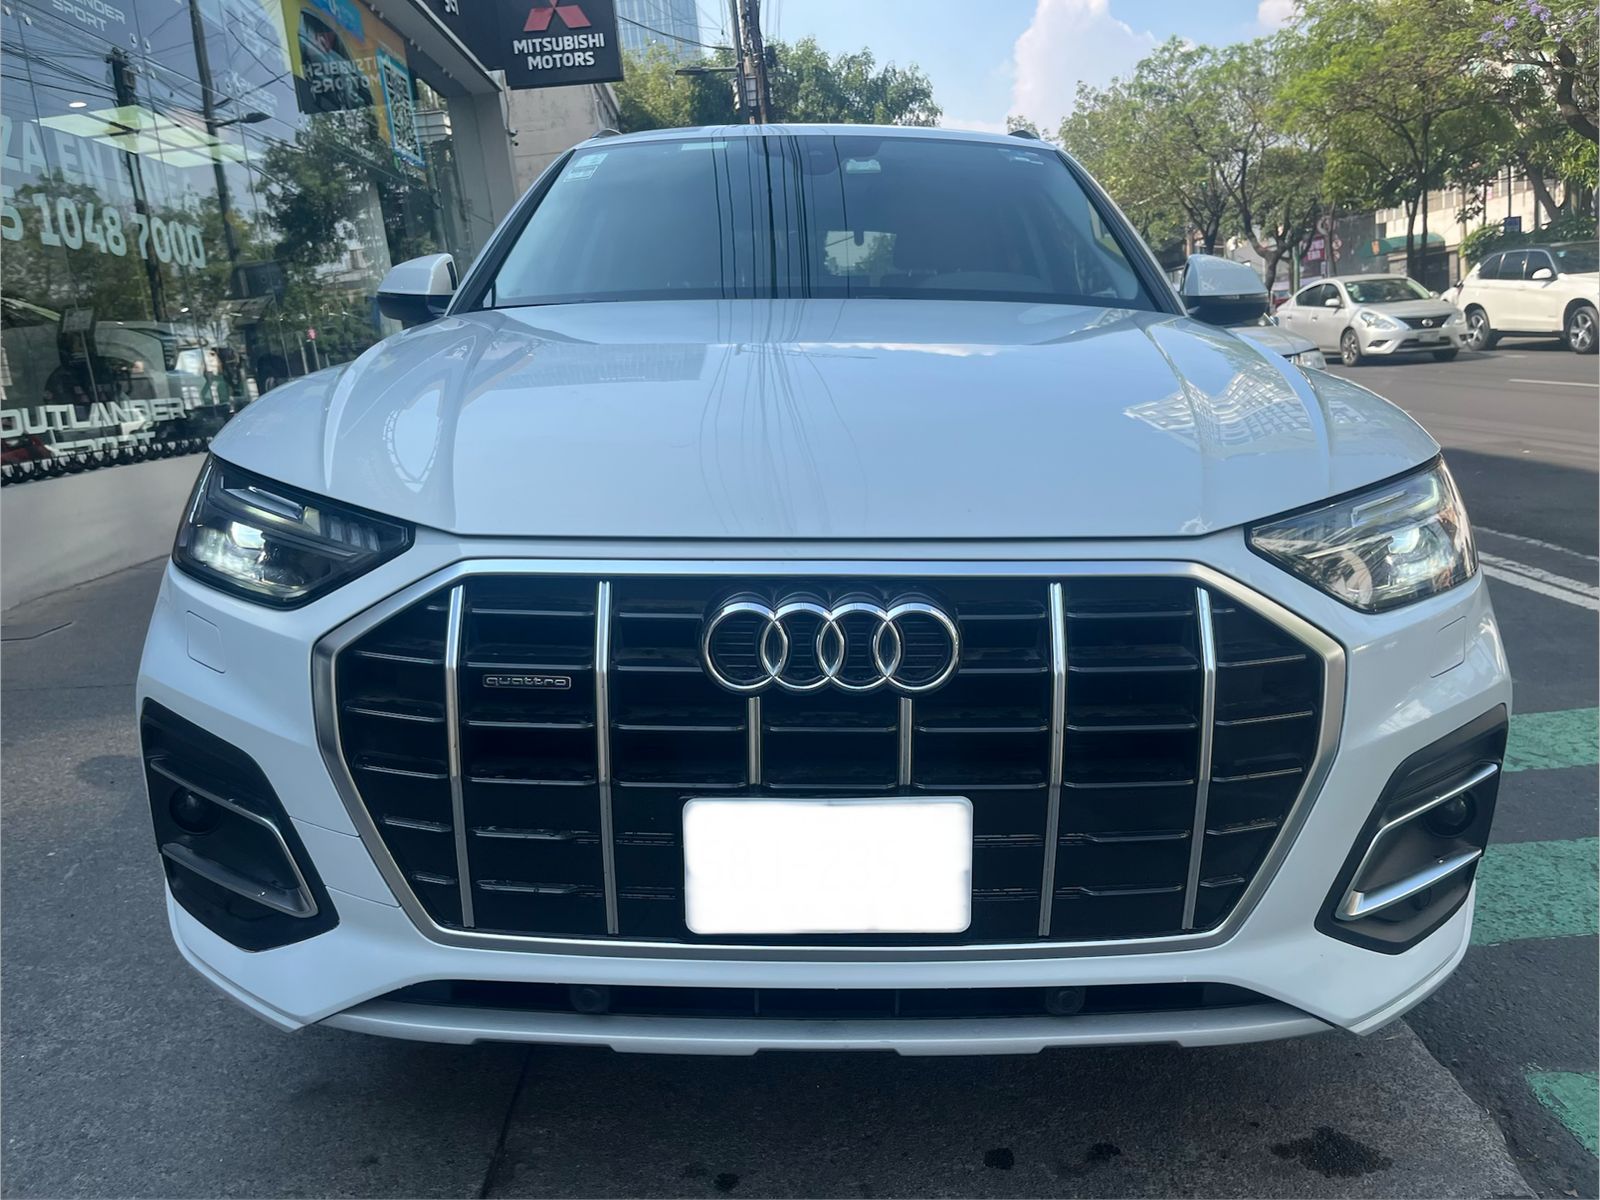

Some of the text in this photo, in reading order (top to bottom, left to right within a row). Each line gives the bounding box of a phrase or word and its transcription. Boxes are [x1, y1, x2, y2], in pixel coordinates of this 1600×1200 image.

[52, 0, 107, 31] SPORT
[513, 33, 605, 54] MITSUBISHI
[527, 51, 595, 70] MOTORS
[32, 193, 127, 257] 1048
[130, 212, 206, 269] 7000
[0, 398, 187, 439] OUTLANDER
[485, 676, 567, 687] quattro
